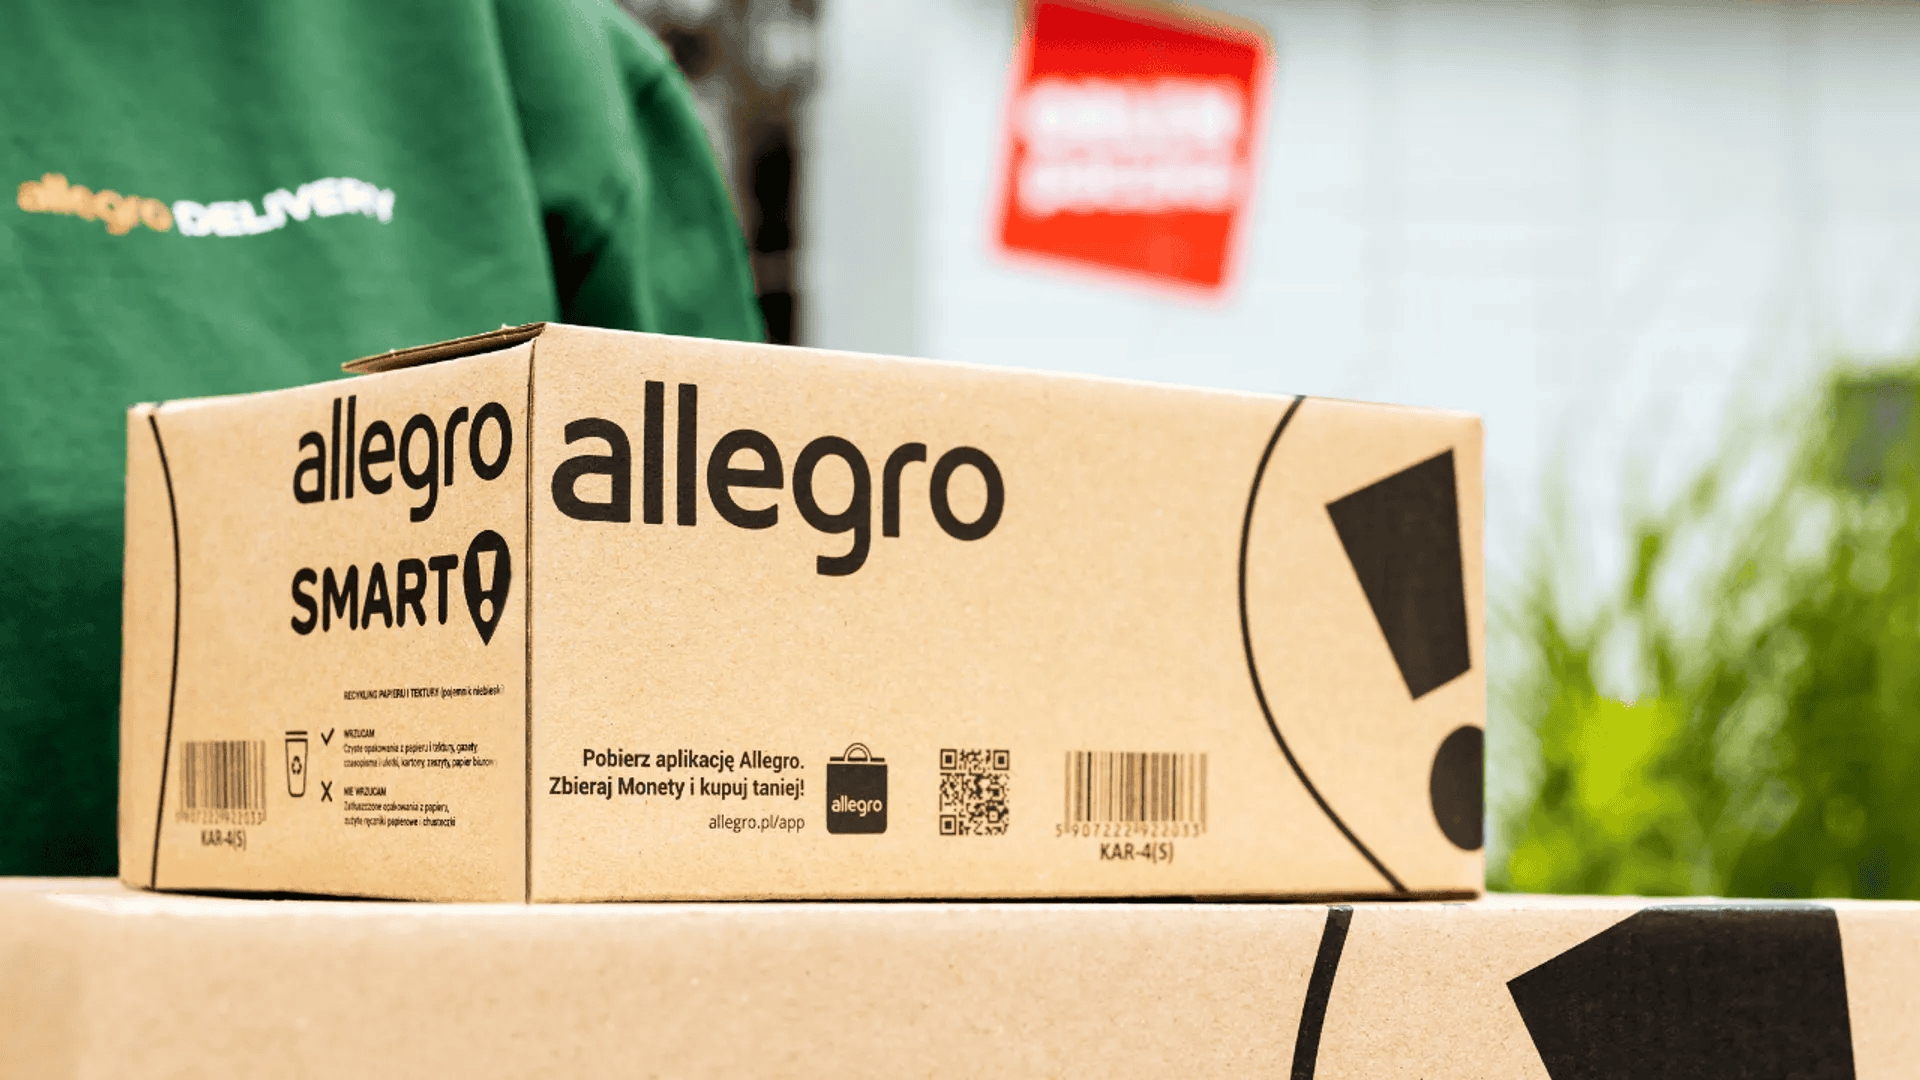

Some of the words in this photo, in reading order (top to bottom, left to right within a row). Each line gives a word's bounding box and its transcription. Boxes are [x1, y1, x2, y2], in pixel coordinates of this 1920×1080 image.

[172, 176, 396, 237] DELIVERY
[292, 394, 514, 524] allegro
[550, 380, 1006, 577] allegro
[410, 687, 440, 699] TEKTURY
[582, 748, 651, 768] Pobierz
[655, 749, 735, 774] aplikację
[739, 750, 805, 774] Allegro.
[549, 776, 613, 801] Zbieraj
[617, 777, 685, 801] Monety
[689, 777, 695, 797] i
[699, 777, 748, 801] kupuj
[752, 779, 805, 801] taniej!
[831, 794, 883, 817] allegro
[708, 814, 806, 834] allegro.pl/app
[200, 828, 248, 851] KAR-4(S)
[1099, 841, 1175, 864] KAR-4(S)
